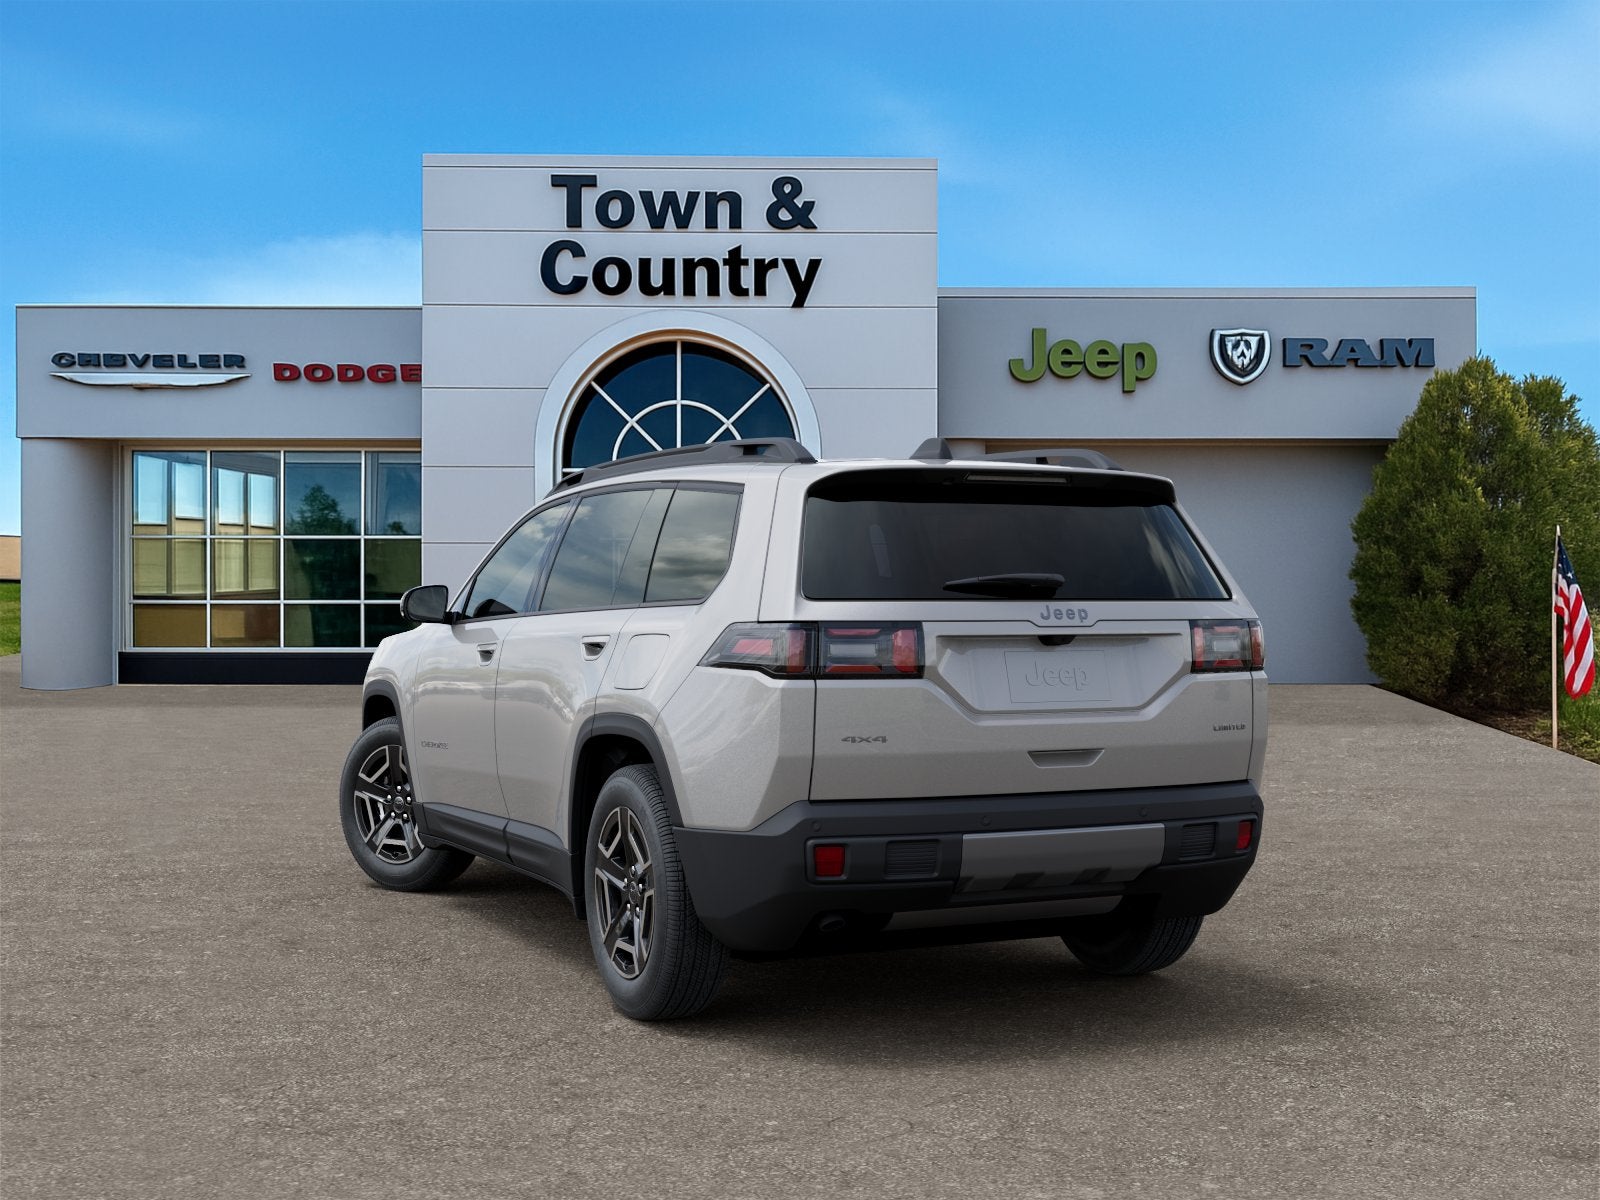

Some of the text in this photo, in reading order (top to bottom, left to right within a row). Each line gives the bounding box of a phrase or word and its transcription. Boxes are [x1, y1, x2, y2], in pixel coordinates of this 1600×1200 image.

[550, 174, 818, 230] Town &
[540, 239, 822, 308] Country
[1008, 328, 1157, 393] Jeep
[1282, 337, 1435, 367] RAM
[273, 363, 422, 383] DODGE
[1040, 604, 1088, 623] Jeep
[1024, 656, 1088, 691] Jeep
